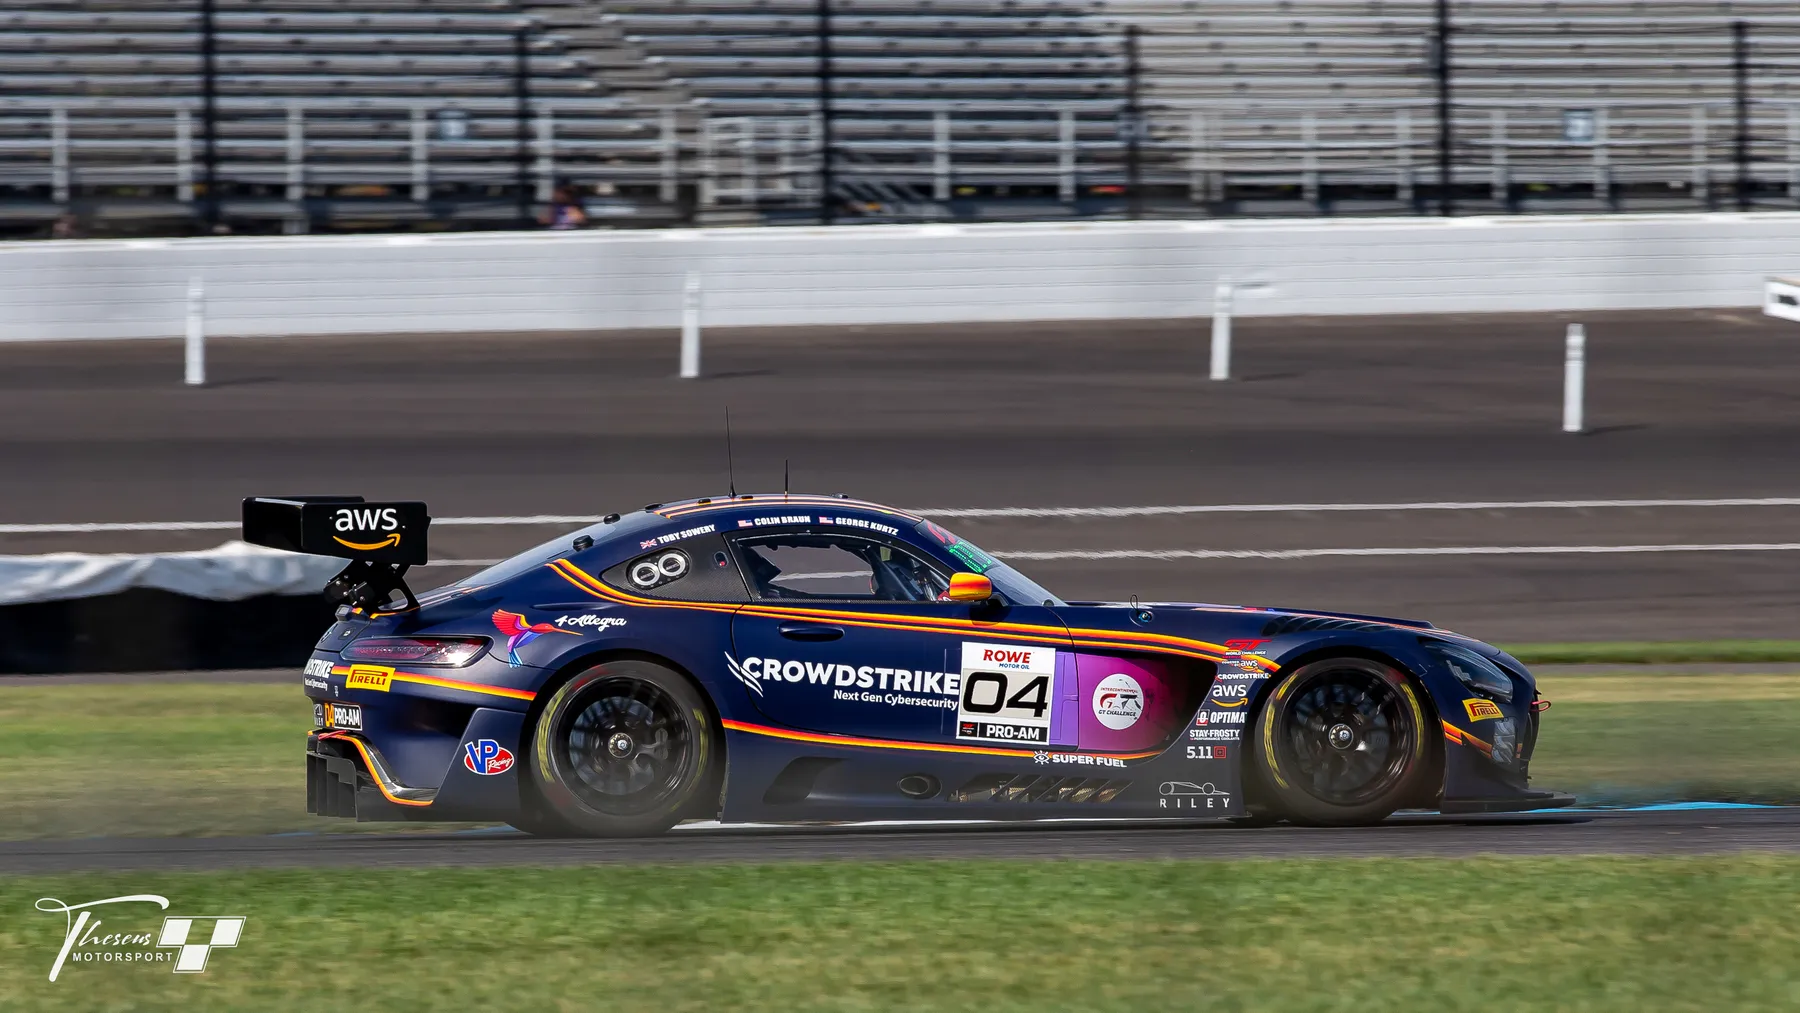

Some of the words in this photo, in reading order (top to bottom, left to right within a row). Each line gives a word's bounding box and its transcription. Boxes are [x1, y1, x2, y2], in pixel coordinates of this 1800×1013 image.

[335, 508, 398, 531] aws
[754, 517, 779, 526] COLIN
[780, 515, 811, 524] BRAUN
[835, 517, 869, 528] GEORGE
[870, 522, 899, 535] KURTZ
[658, 535, 680, 544] TOBY
[681, 524, 716, 539] SOWERY
[983, 649, 1031, 664] ROWE
[349, 669, 389, 685] PIRELLI
[742, 656, 960, 695] CROWDSTRIKE
[963, 672, 1050, 718] 04
[1212, 684, 1247, 697] aws
[834, 689, 859, 701] Next
[861, 692, 882, 703] Gen
[885, 694, 958, 710] Cybersecurity
[335, 708, 360, 726] PRO-AM
[1210, 712, 1245, 723] OPTIMA
[1469, 703, 1500, 717] PIRELLI
[986, 725, 1040, 740] PRO-AM
[465, 739, 499, 775] VP
[1186, 746, 1213, 759] 5.11
[487, 757, 513, 771] Racing
[1052, 754, 1094, 766] SUPER
[1096, 757, 1127, 768] FUEL
[1160, 798, 1230, 808] RILEY
